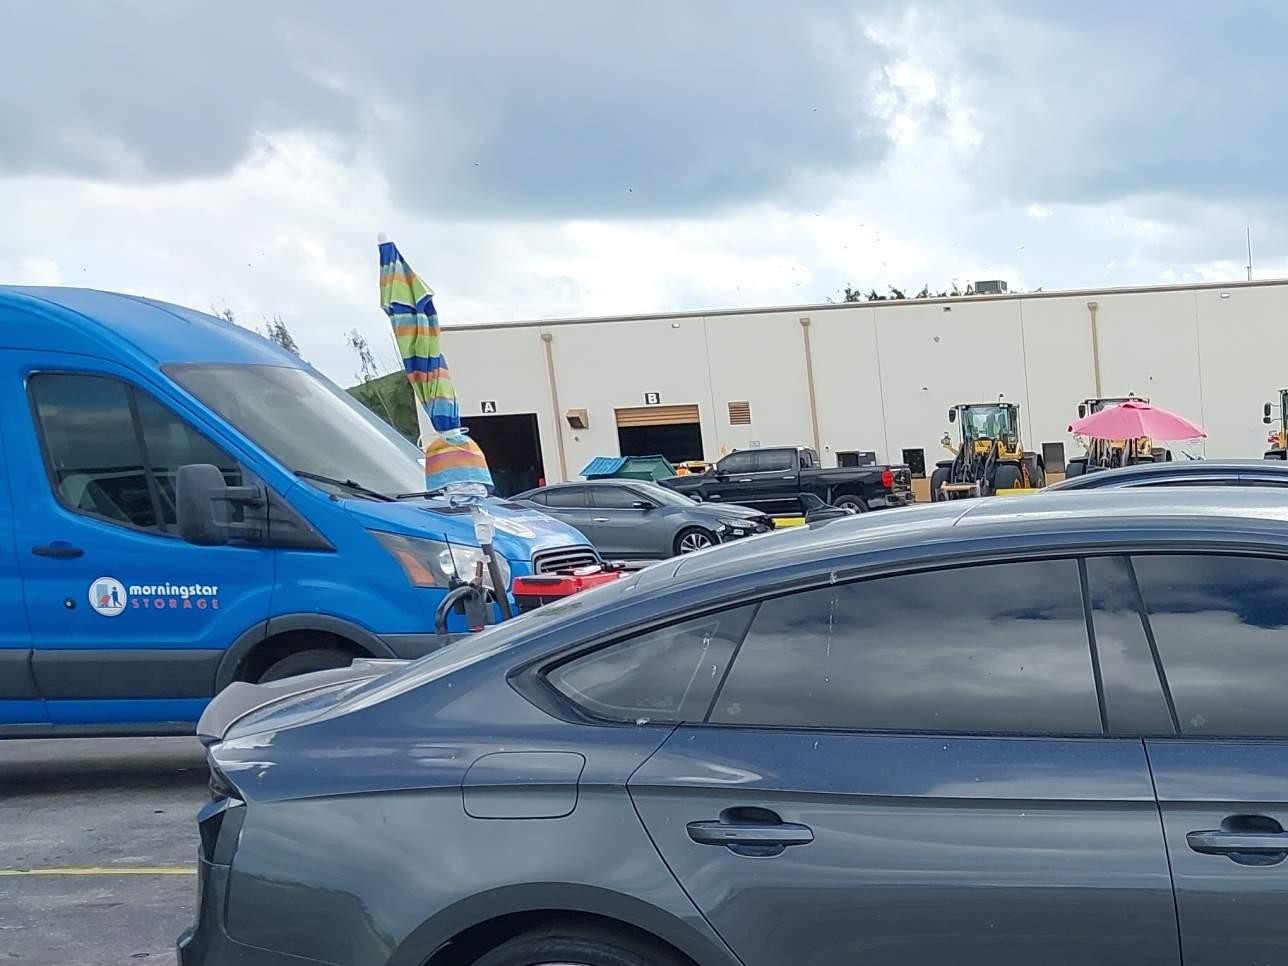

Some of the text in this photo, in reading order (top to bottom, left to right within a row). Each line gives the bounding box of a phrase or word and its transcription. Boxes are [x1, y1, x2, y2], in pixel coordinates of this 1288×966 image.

[647, 393, 658, 404] B
[483, 402, 494, 413] A
[129, 582, 218, 599] morningstar
[131, 599, 220, 609] STORAGE
